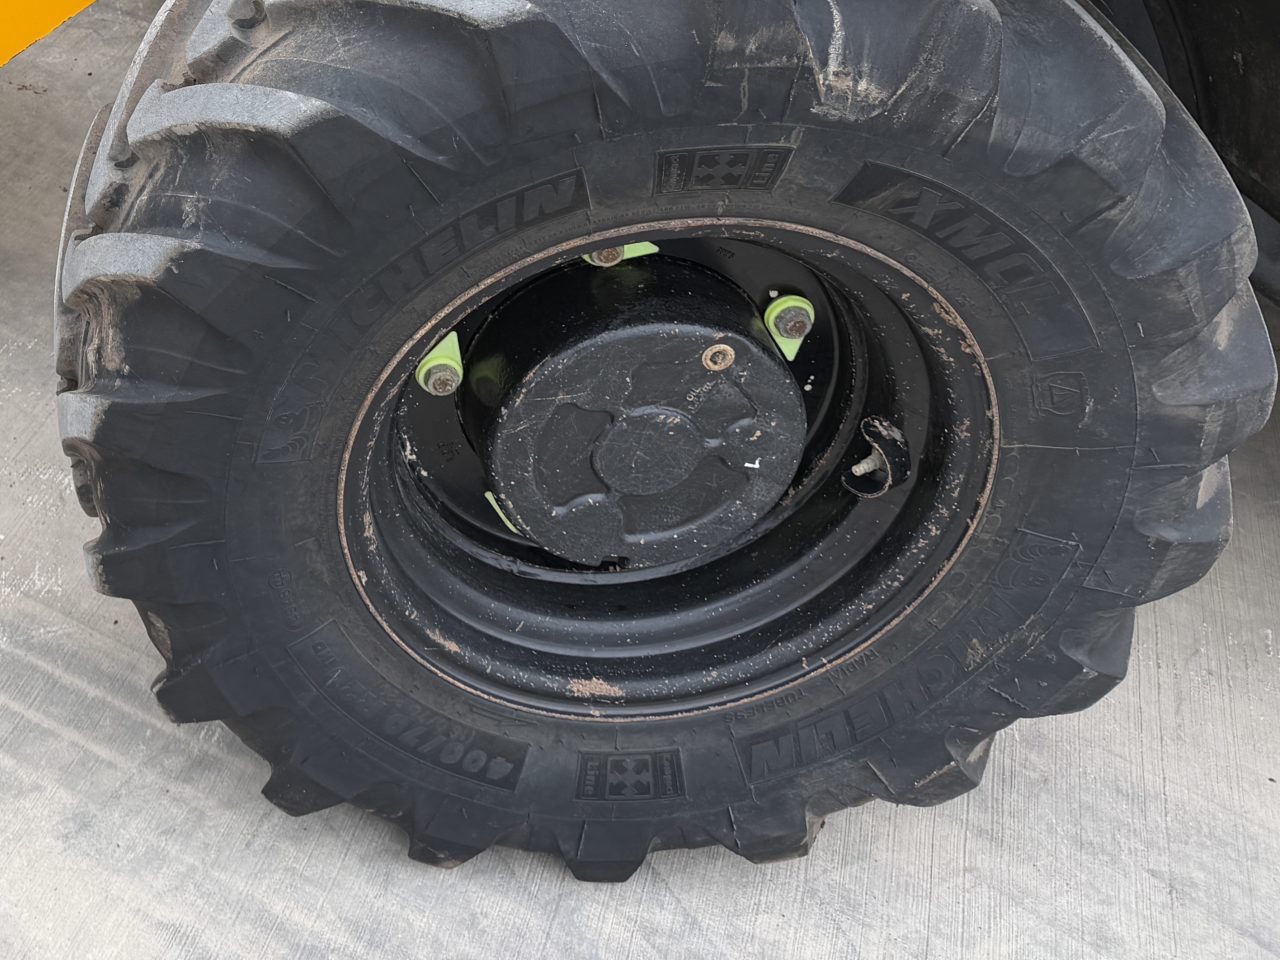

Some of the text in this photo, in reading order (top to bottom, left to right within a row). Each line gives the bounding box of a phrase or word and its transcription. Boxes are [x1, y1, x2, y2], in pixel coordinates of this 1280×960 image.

[888, 186, 1061, 315] XMCL
[827, 649, 879, 682] RADIAL
[724, 689, 806, 721] TUBELESS
[584, 761, 599, 794] Line
